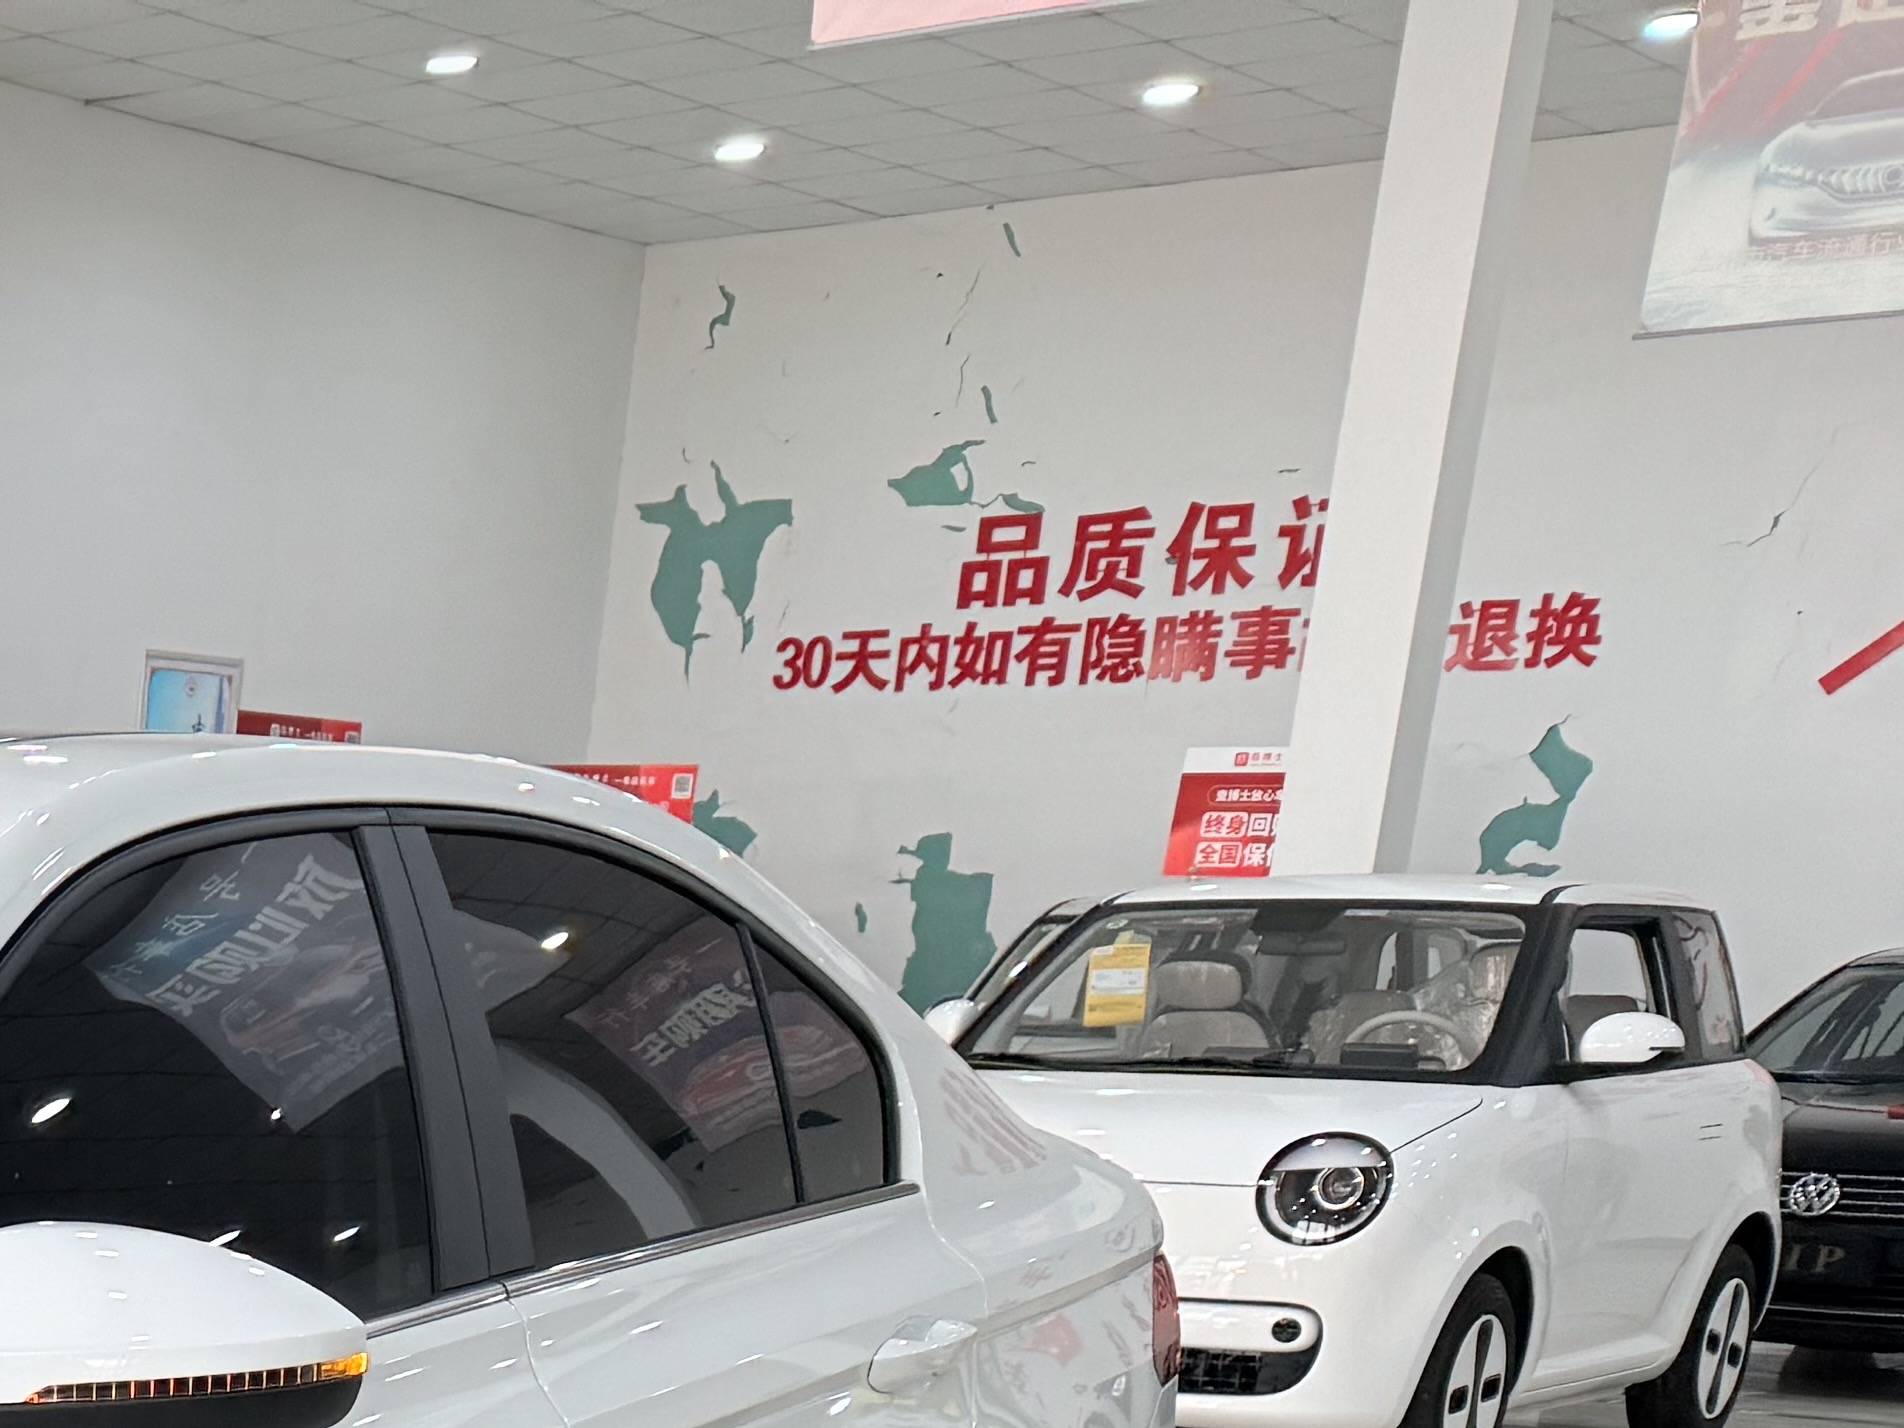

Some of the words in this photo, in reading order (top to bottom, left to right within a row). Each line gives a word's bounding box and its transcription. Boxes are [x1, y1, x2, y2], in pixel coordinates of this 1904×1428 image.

[772, 603, 1310, 694] 30天内如有隐瞒事
[1444, 590, 1603, 673] 退换
